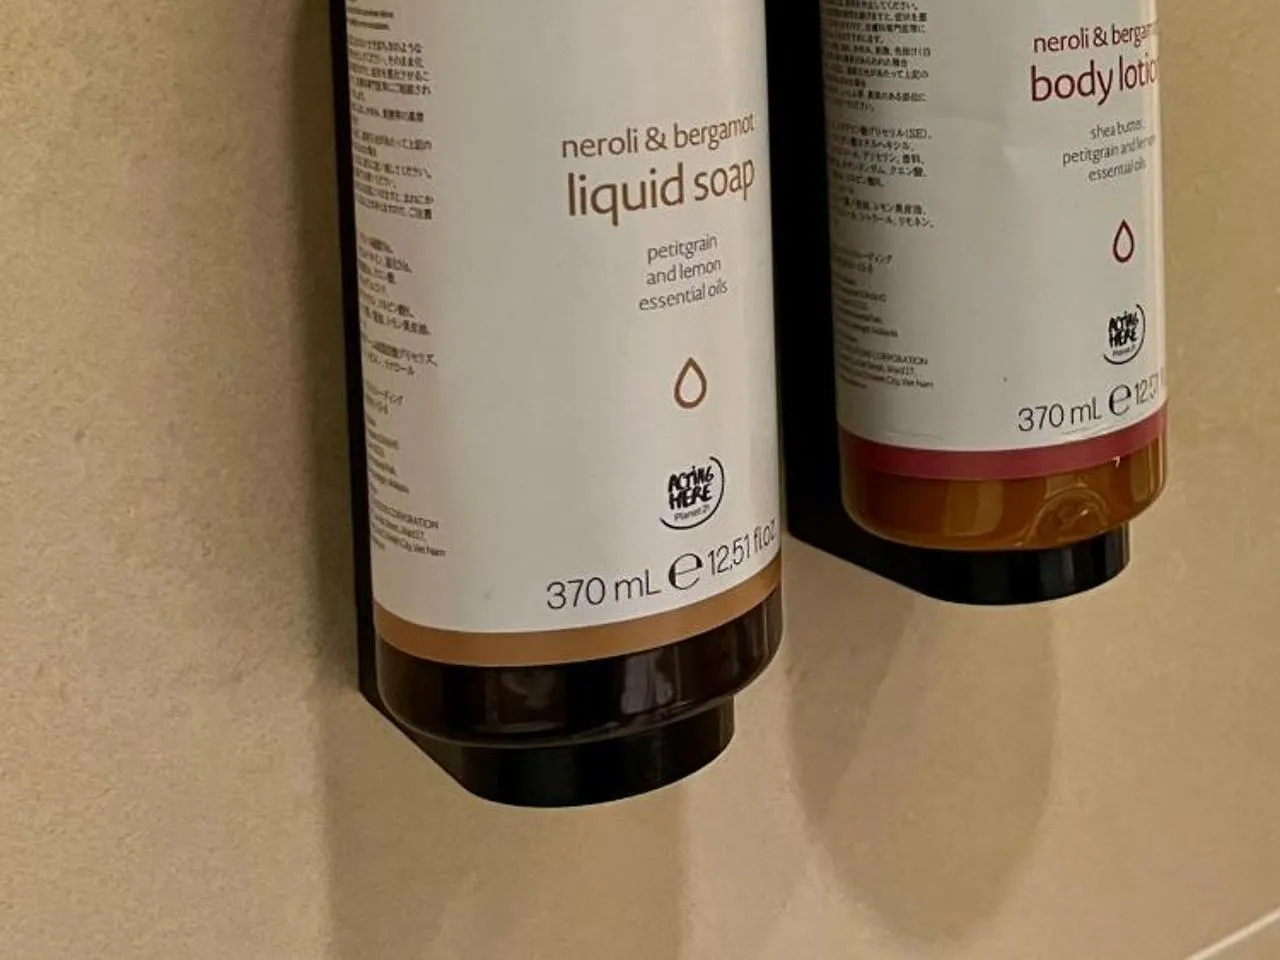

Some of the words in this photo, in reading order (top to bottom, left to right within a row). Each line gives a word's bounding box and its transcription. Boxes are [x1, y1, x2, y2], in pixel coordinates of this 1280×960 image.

[1034, 27, 1090, 53] neroli
[1093, 26, 1108, 48] &
[1030, 59, 1114, 106] body
[1119, 52, 1158, 92] lotio
[562, 127, 639, 158] neroli
[645, 127, 668, 151] &
[674, 113, 755, 150] bergamot
[1090, 123, 1116, 140] shea
[1063, 144, 1119, 167] petitgrain
[1121, 136, 1136, 154] and
[1088, 158, 1134, 182] essential
[568, 161, 685, 227] liquid
[694, 159, 755, 201] soap
[647, 234, 718, 264] petitgrain
[647, 264, 677, 285] and
[679, 258, 721, 280] lemon
[639, 284, 706, 311] essential
[708, 279, 728, 297] oils
[1018, 403, 1065, 432] 370
[1070, 396, 1103, 426] mL
[669, 483, 712, 510] HERE
[546, 577, 606, 609] 370
[614, 569, 662, 601] mL
